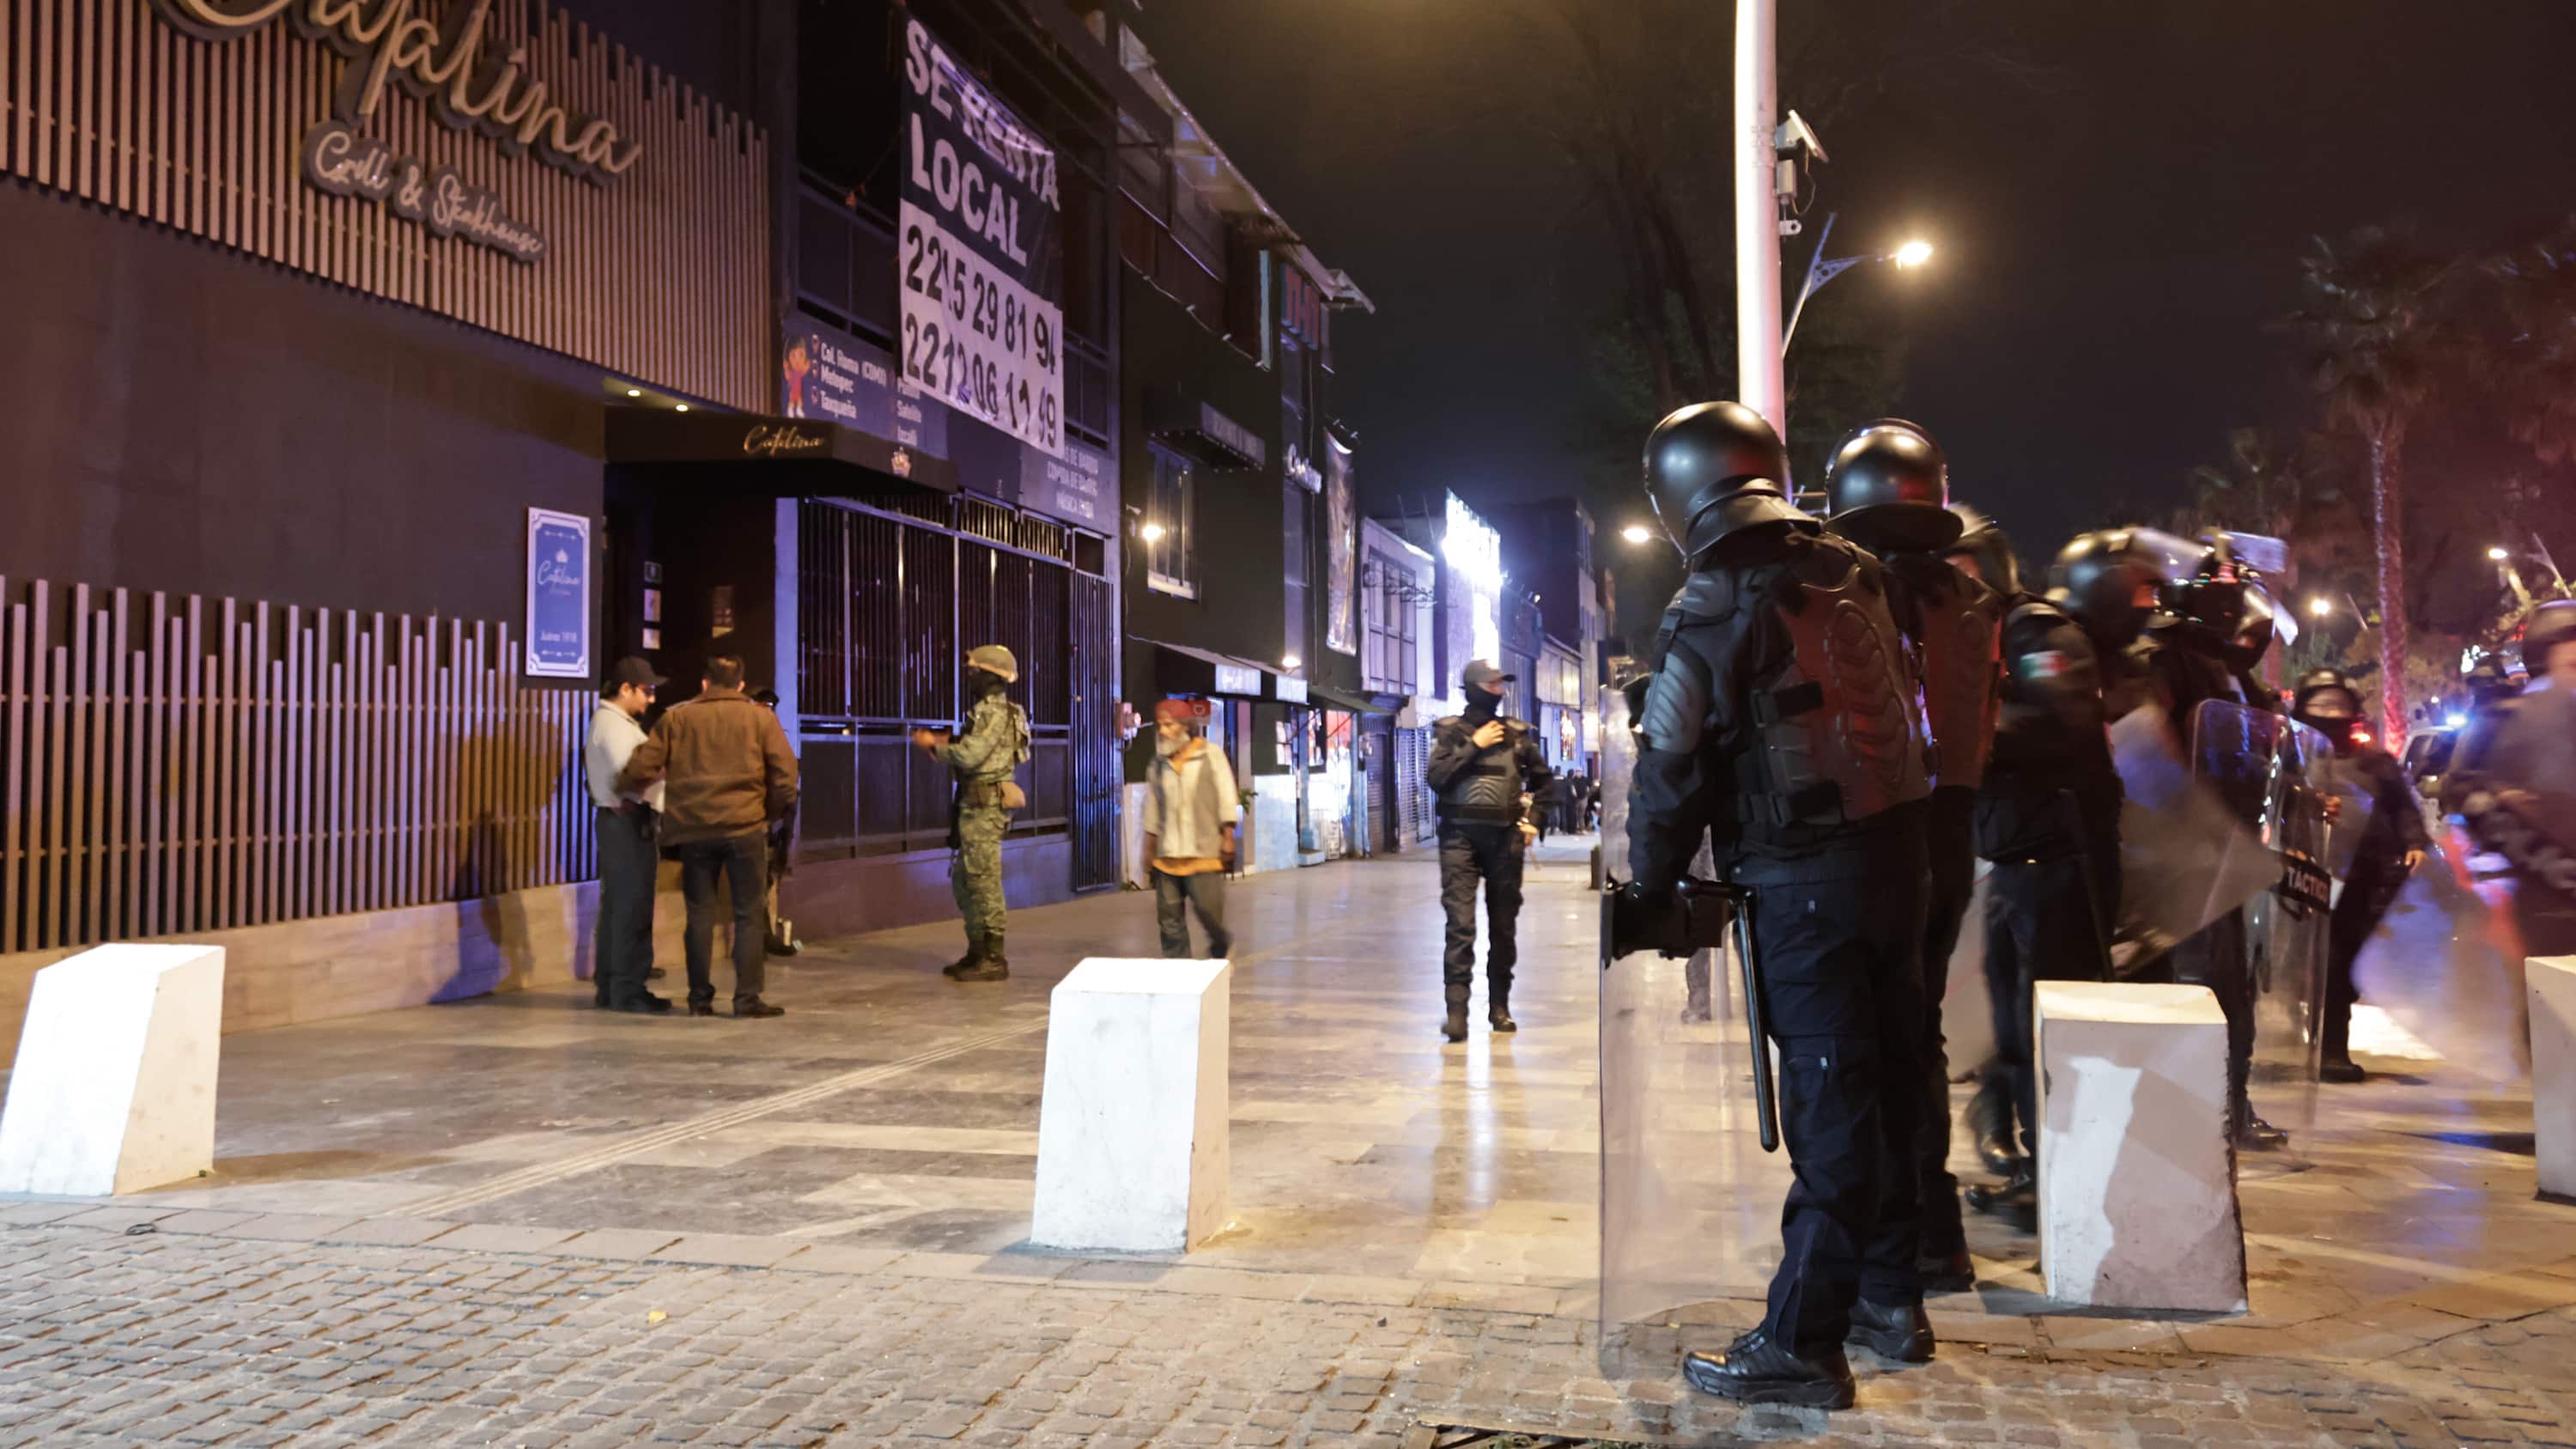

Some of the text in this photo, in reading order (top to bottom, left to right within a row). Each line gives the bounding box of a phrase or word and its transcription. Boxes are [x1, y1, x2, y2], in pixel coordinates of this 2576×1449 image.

[906, 19, 956, 122] SE
[315, 131, 544, 253] Grill & Steakhouse
[911, 112, 1027, 268] LOCAL
